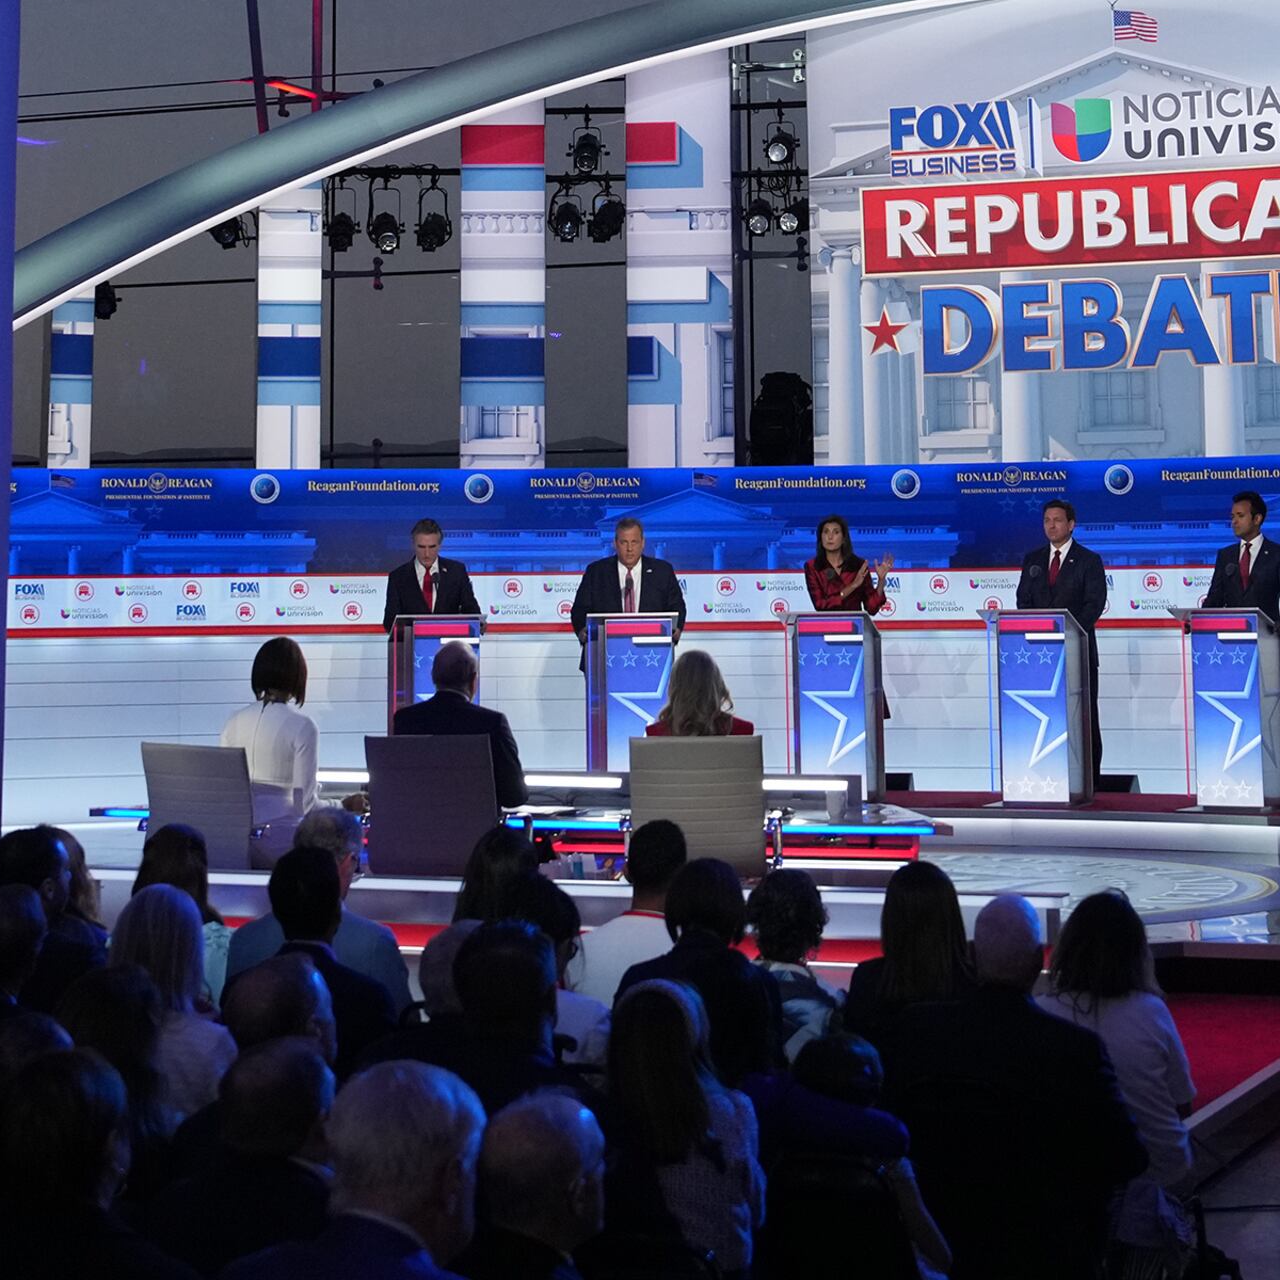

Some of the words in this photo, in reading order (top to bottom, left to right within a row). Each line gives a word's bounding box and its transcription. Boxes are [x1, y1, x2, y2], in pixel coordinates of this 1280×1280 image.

[889, 100, 1015, 151] FOX
[891, 152, 1016, 178] BUSINESS
[956, 472, 1003, 482] RONALD
[1022, 470, 1067, 481] REAGAN
[101, 478, 148, 488] RONALD
[168, 478, 213, 488] REAGAN
[308, 480, 439, 493] ReaganFoundation.org
[530, 477, 576, 488] RONALD
[596, 477, 640, 487] REAGAN
[735, 476, 866, 490] ReaganFoundation.org
[15, 584, 45, 595] FOX
[230, 582, 260, 593] FOX
[177, 605, 206, 616] FOX
